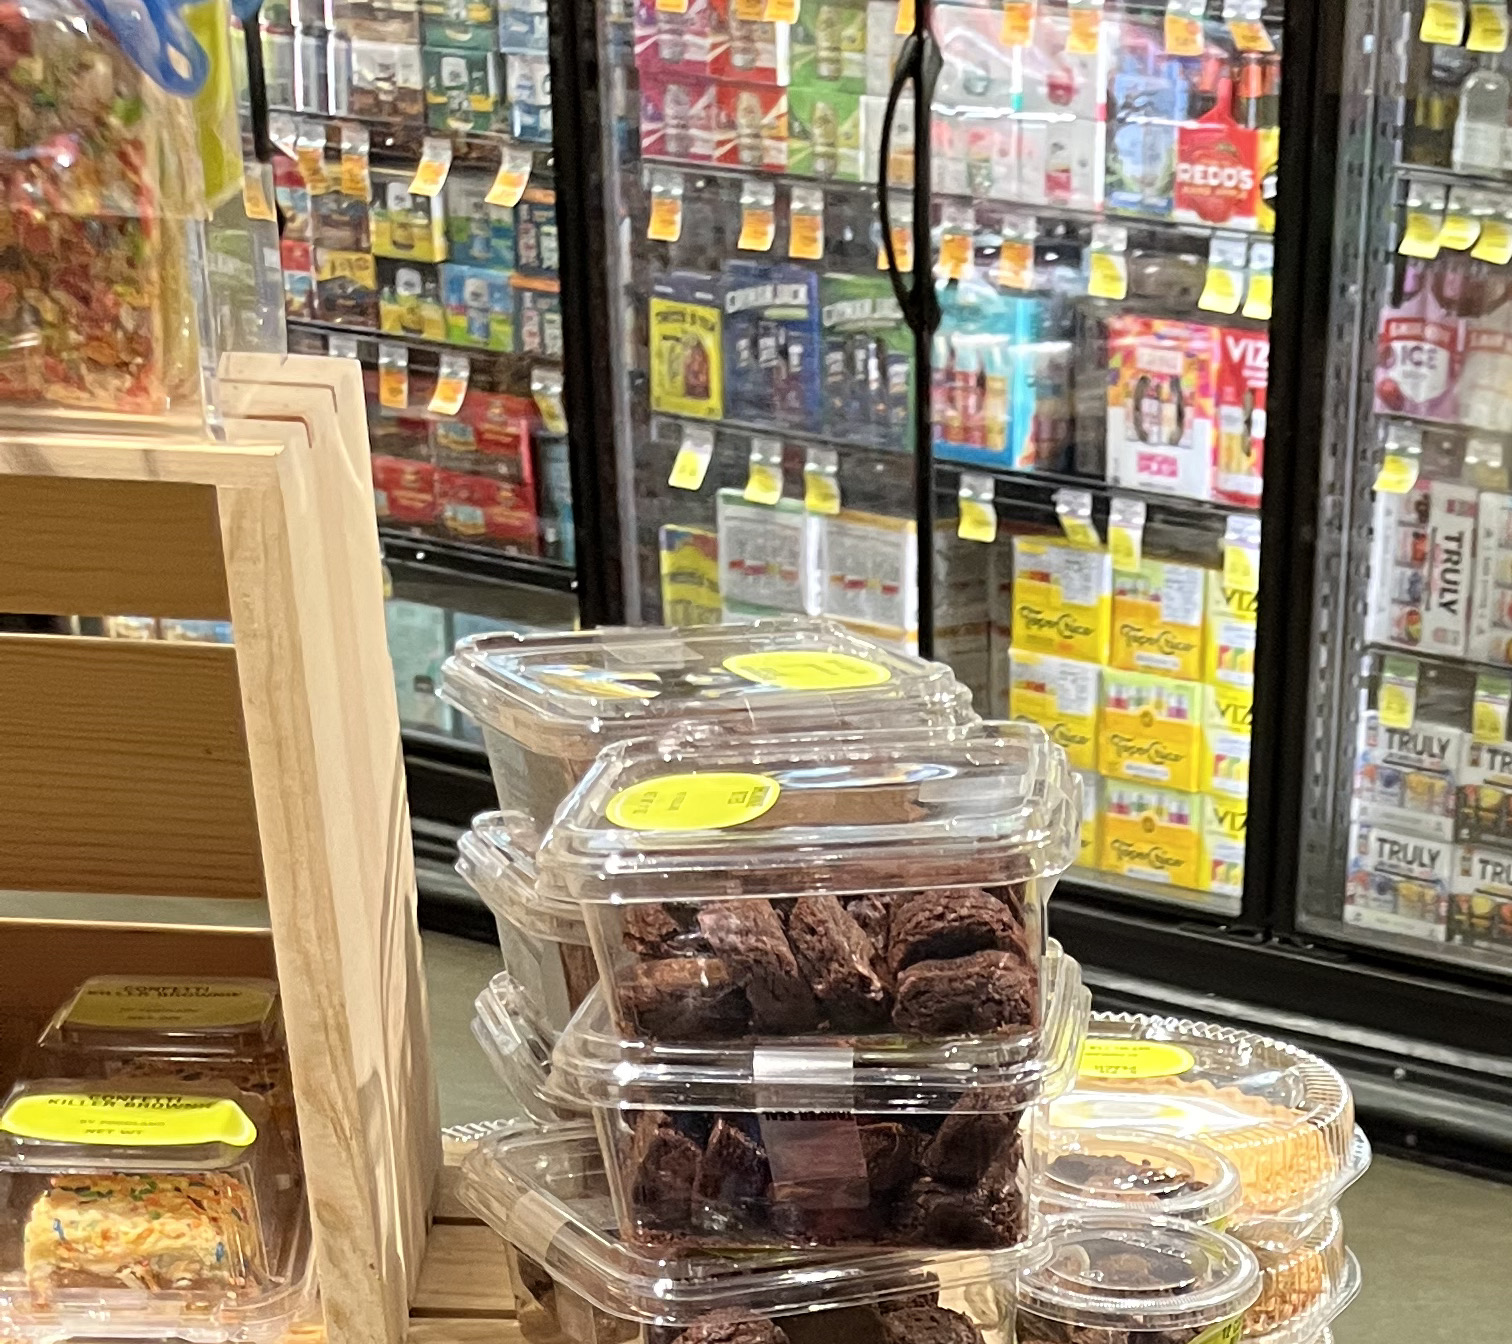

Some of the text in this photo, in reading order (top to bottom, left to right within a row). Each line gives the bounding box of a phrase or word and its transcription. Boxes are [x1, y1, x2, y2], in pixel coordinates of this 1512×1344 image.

[1437, 529, 1464, 615] TRULY
[1385, 728, 1451, 757] TRULY
[1375, 836, 1441, 870] TRULY
